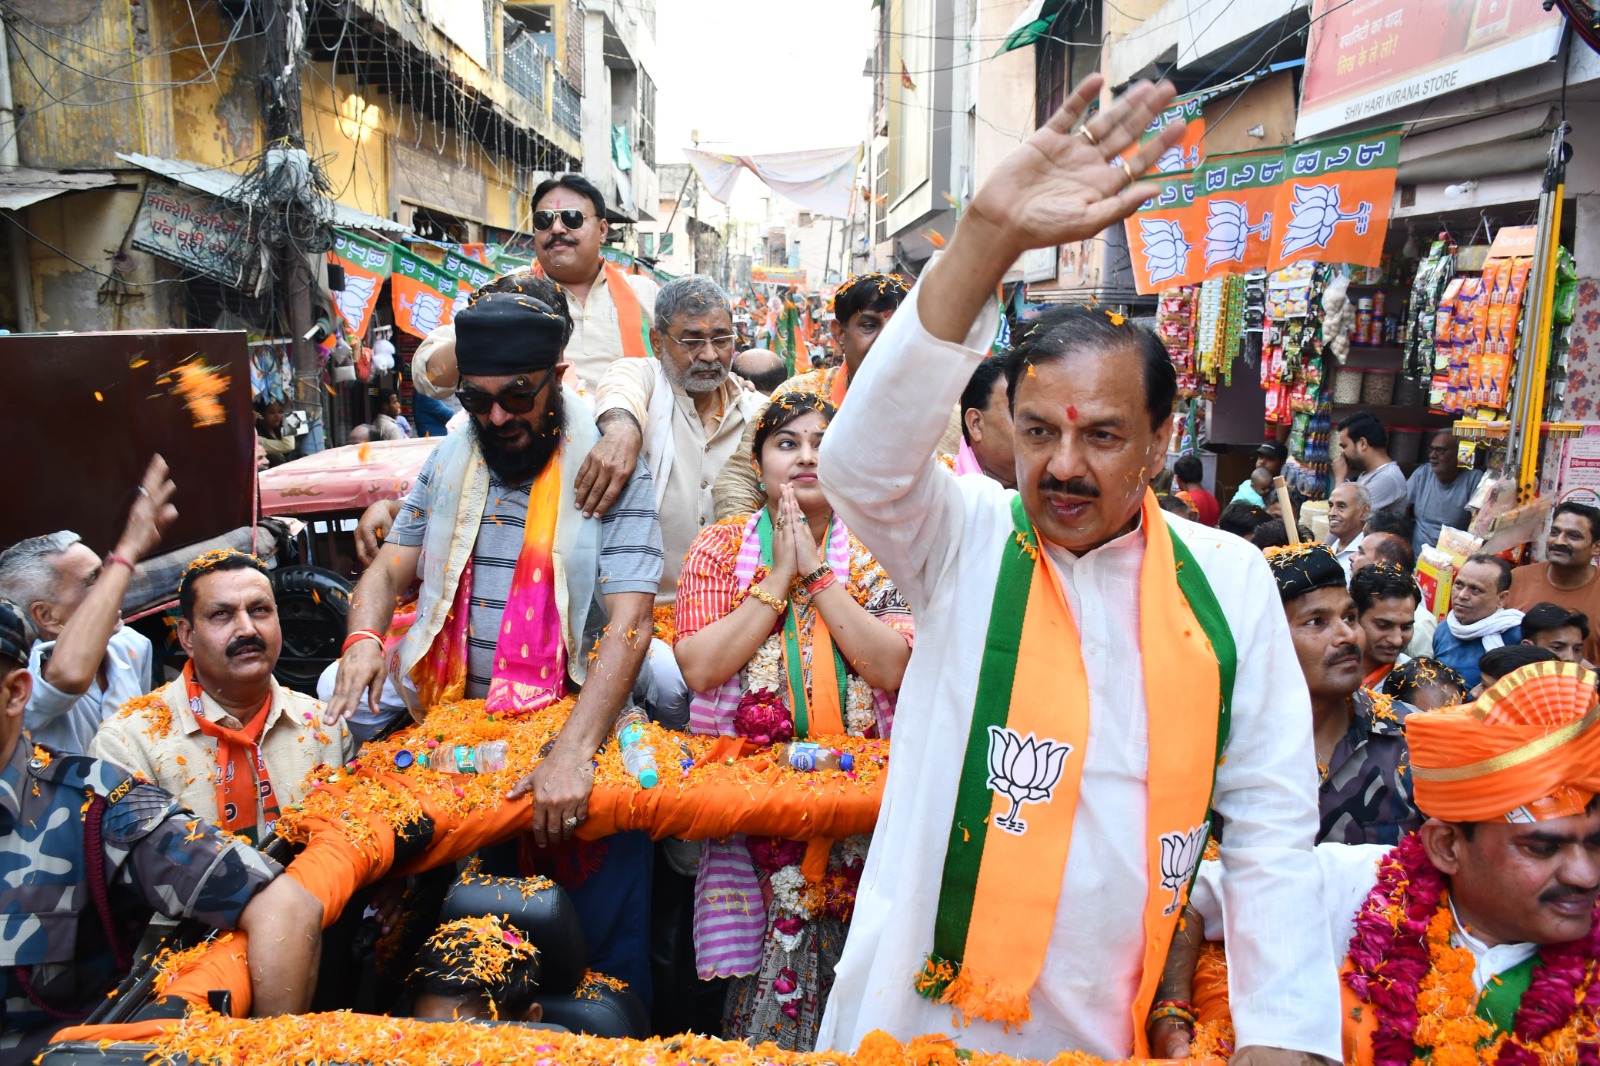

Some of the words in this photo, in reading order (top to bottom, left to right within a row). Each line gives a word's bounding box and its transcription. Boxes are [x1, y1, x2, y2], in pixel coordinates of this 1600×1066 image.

[1371, 18, 1383, 35] का
[1344, 102, 1362, 121] SHIV
[1364, 96, 1384, 114] HARI
[1386, 86, 1420, 107] KIRANA
[1422, 70, 1458, 95] STORE
[109, 778, 132, 804] CISF
